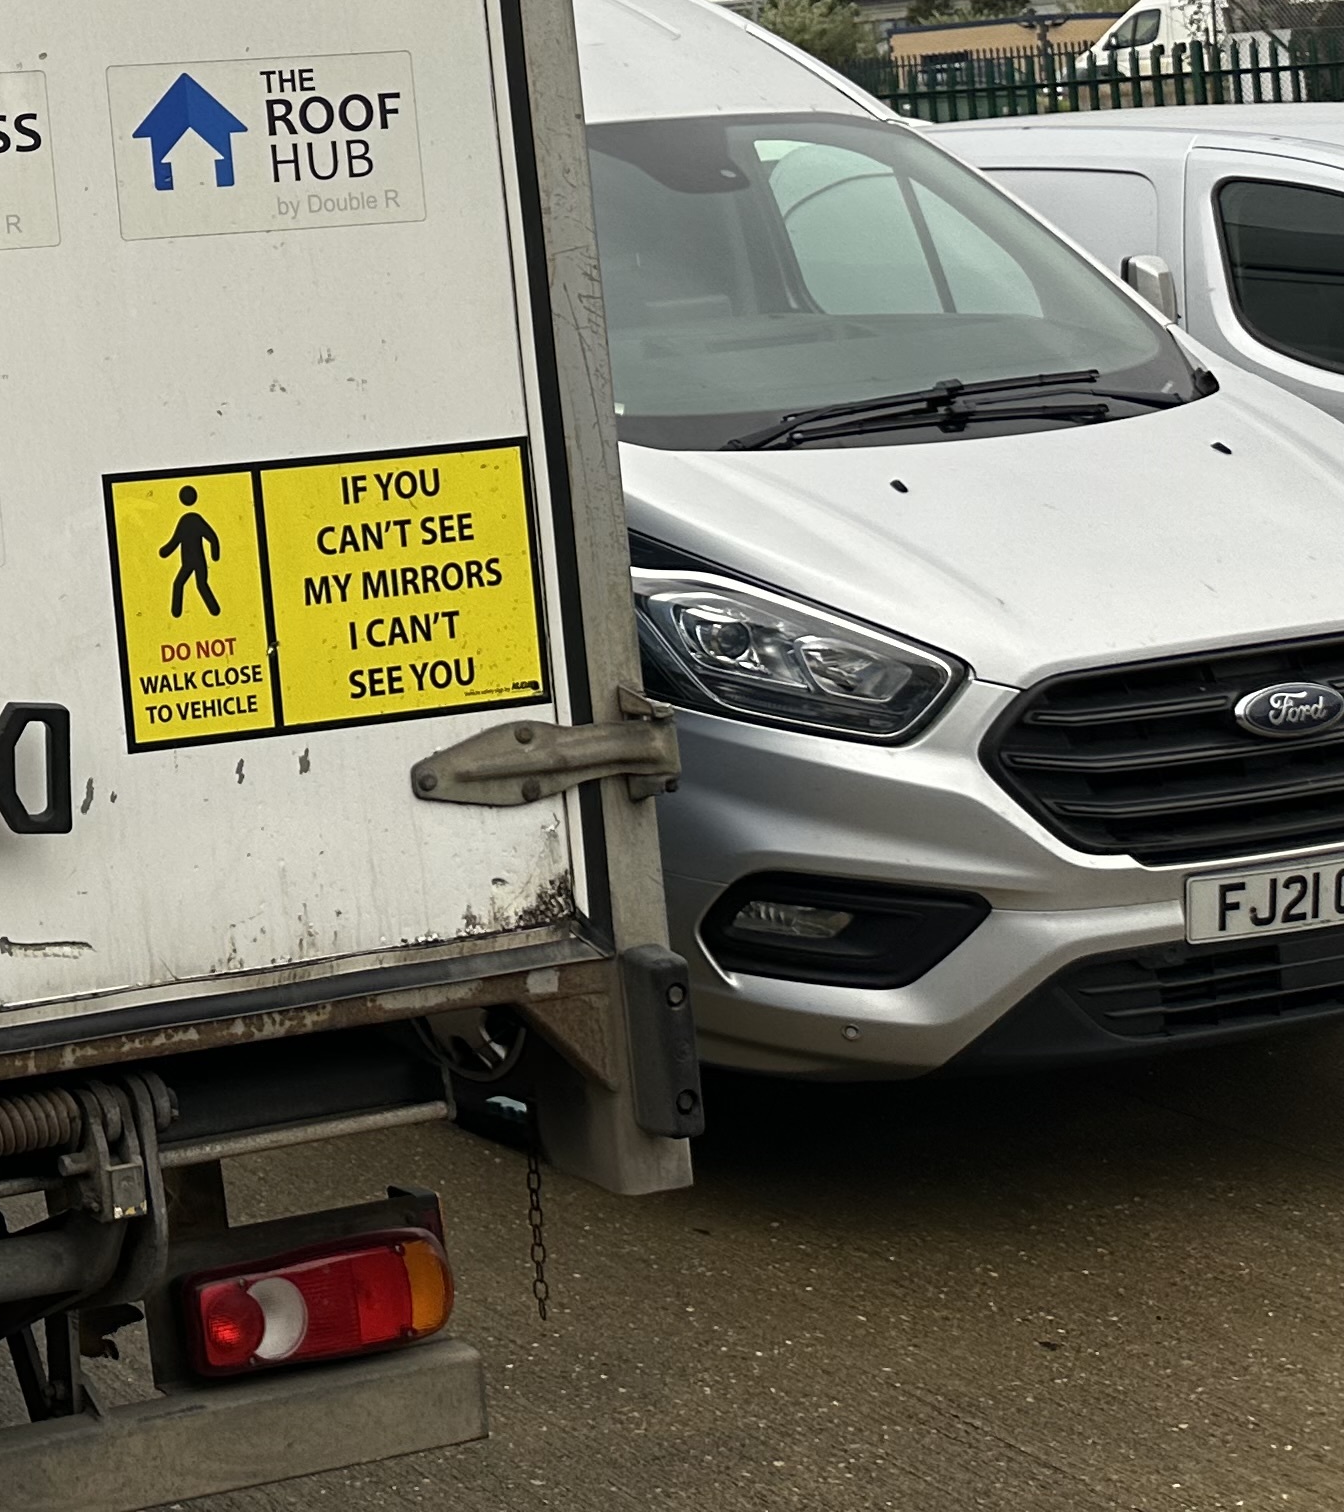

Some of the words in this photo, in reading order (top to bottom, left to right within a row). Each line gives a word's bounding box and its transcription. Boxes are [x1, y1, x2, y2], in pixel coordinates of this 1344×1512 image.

[260, 68, 315, 94] THE
[264, 92, 401, 138] ROOF
[270, 139, 374, 183] HUB
[276, 197, 302, 218] by
[306, 192, 380, 214] Double
[384, 189, 400, 209] R
[5, 214, 22, 235] R
[341, 474, 368, 506] IF
[374, 467, 440, 502] YOU
[420, 512, 475, 547] SEE
[304, 574, 353, 606] MY
[361, 557, 503, 601] MIRRORS
[160, 642, 192, 663] DO
[196, 637, 237, 659] NOT
[349, 621, 358, 651] I
[140, 672, 198, 695] WALK
[201, 664, 263, 688] CLOSE
[349, 664, 403, 699] SEE
[409, 657, 476, 692] YOU
[145, 705, 174, 724] TO
[176, 694, 258, 721] VEHICLE
[1269, 690, 1326, 725] Ford
[1218, 872, 1320, 932] FJ21
